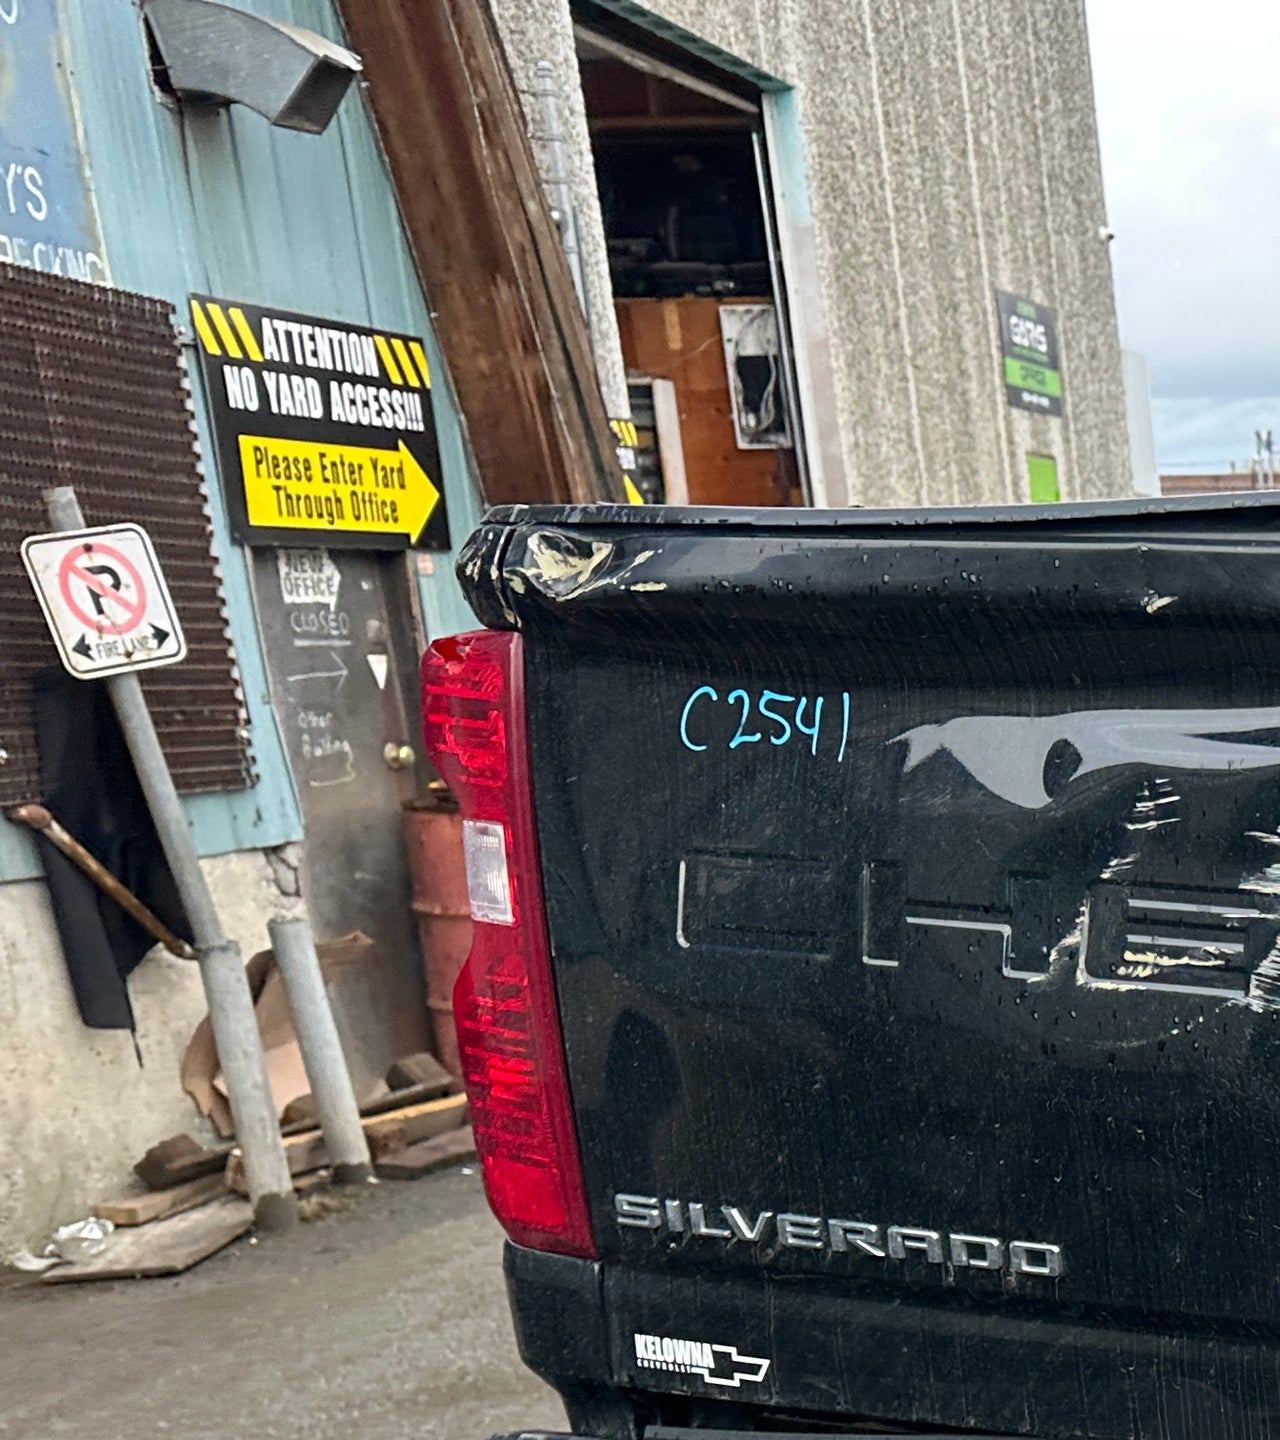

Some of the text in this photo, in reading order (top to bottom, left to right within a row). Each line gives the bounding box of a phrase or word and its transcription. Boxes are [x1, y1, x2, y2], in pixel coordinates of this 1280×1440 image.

[261, 317, 379, 377] ATTENTION
[222, 364, 424, 432] NO YARD ACCESS!!!
[253, 445, 406, 490] Please Enter Yard
[273, 485, 399, 525] Through Office
[284, 576, 335, 598] OFFICE
[290, 609, 350, 635] CLOSED
[679, 686, 850, 762] C2541
[614, 1193, 1063, 1277] SILVERADO
[634, 1333, 715, 1369] KELOWNA
